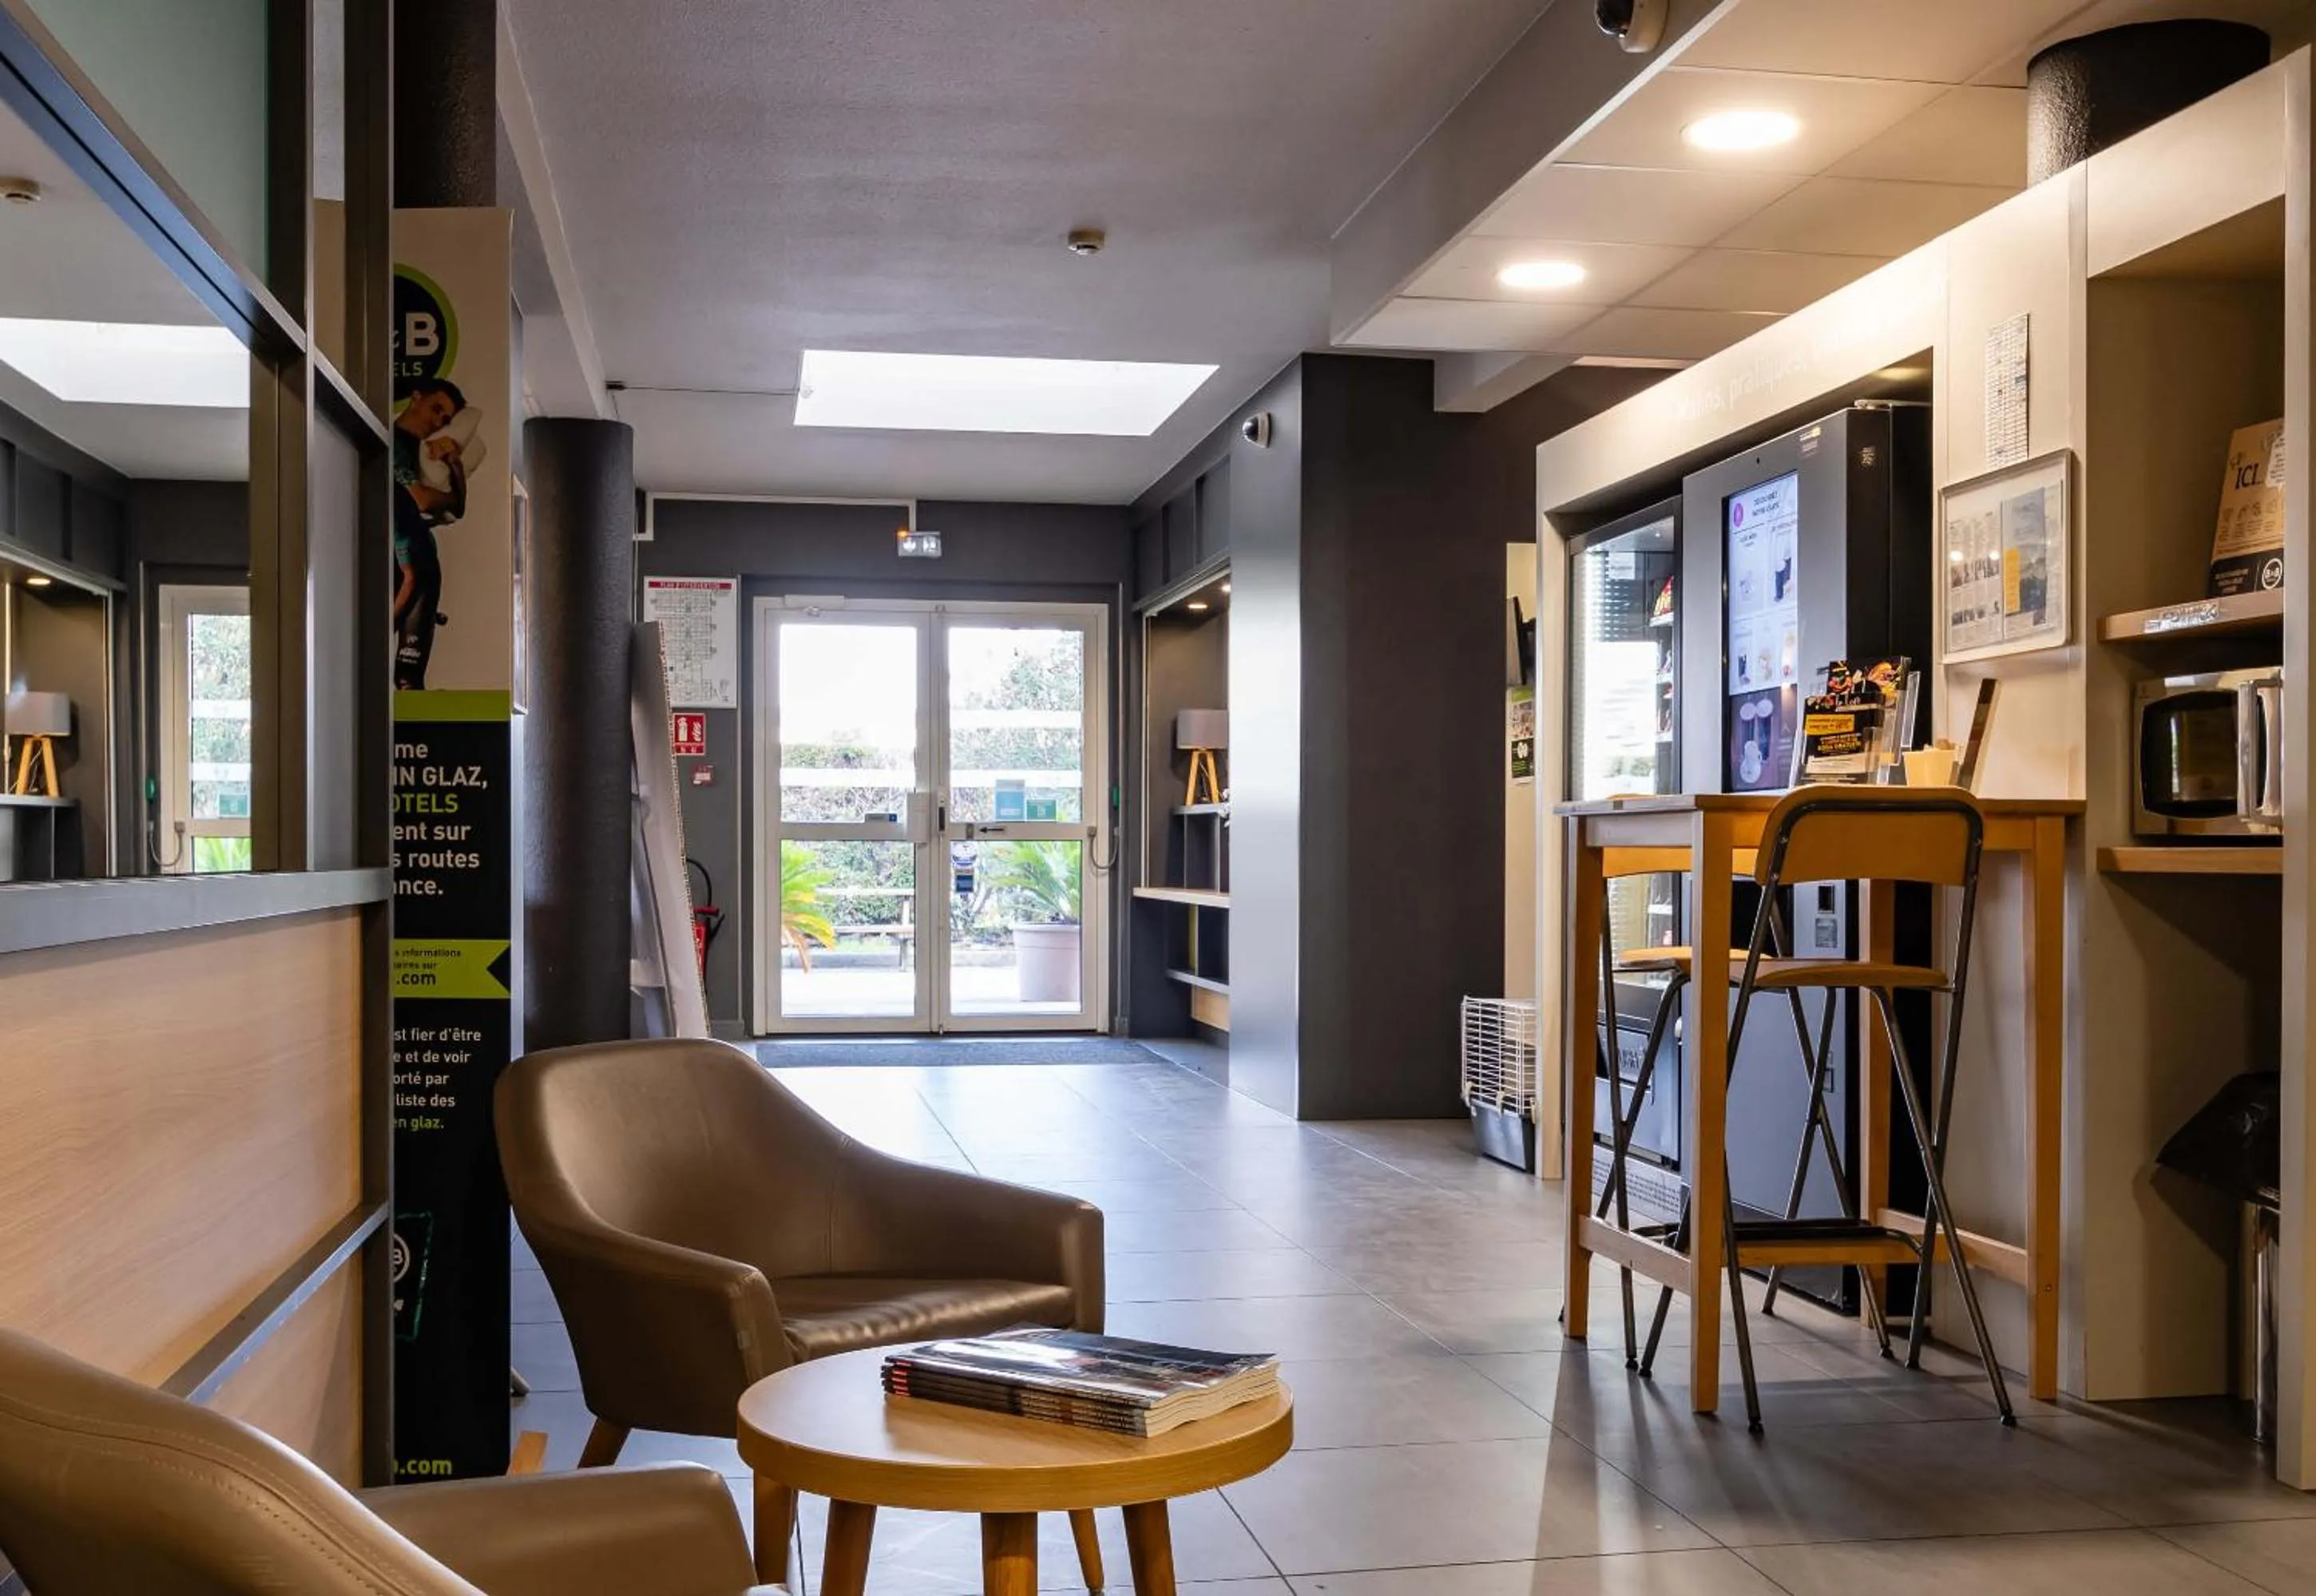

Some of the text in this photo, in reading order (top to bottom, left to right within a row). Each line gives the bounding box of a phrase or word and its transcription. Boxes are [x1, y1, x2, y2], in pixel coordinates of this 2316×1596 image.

[395, 743, 429, 758] me
[422, 766, 489, 790] GLAZ,
[433, 824, 471, 840] sur
[408, 849, 480, 868] routes
[396, 974, 436, 985] .com
[410, 1027, 436, 1041] fier
[439, 1027, 482, 1041] d'être
[405, 1050, 418, 1063] et
[422, 1049, 439, 1063] de
[443, 1050, 471, 1063] voir
[426, 1074, 450, 1087] par
[430, 1093, 456, 1107] des
[410, 1115, 445, 1131] glaz.
